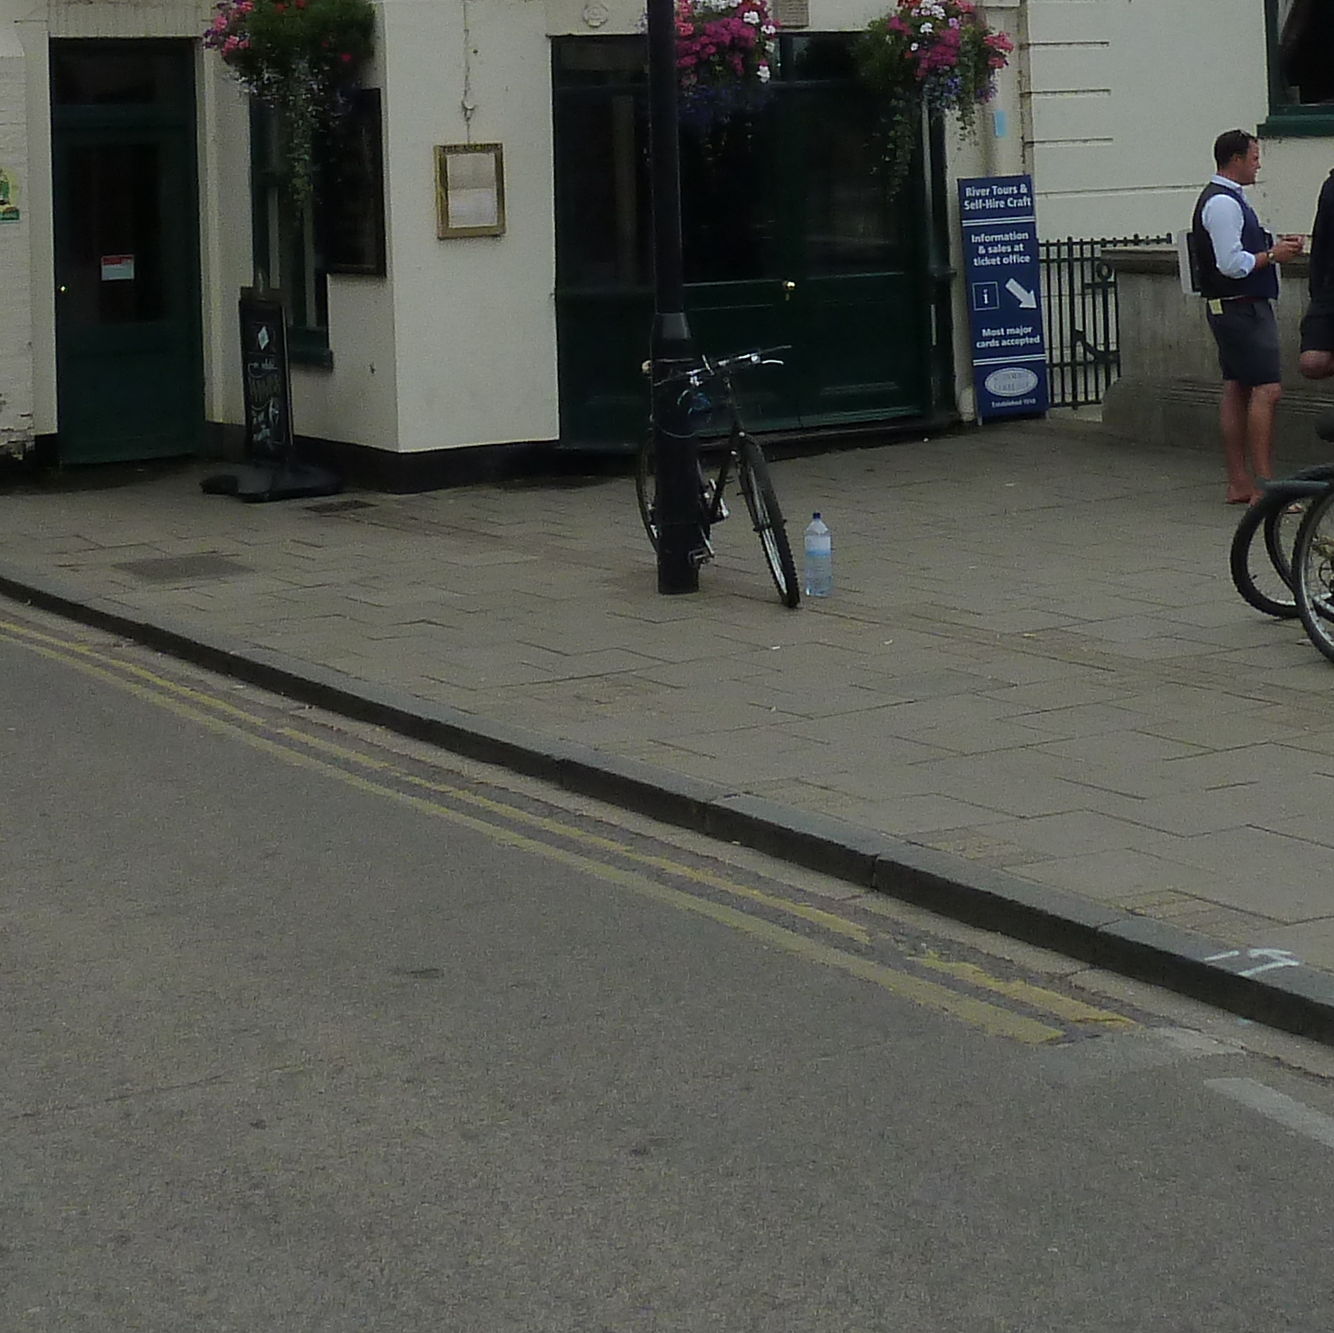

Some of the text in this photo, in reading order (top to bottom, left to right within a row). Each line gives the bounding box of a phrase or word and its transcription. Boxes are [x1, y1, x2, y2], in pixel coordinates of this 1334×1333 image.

[965, 183, 1028, 197] River Tours &
[964, 196, 1031, 210] Self-Hire Craft
[971, 230, 1029, 243] Information
[978, 243, 1024, 254] & sales at
[973, 254, 1031, 266] ticket office
[982, 325, 1033, 337] Most major
[976, 335, 1041, 348] cards accepted
